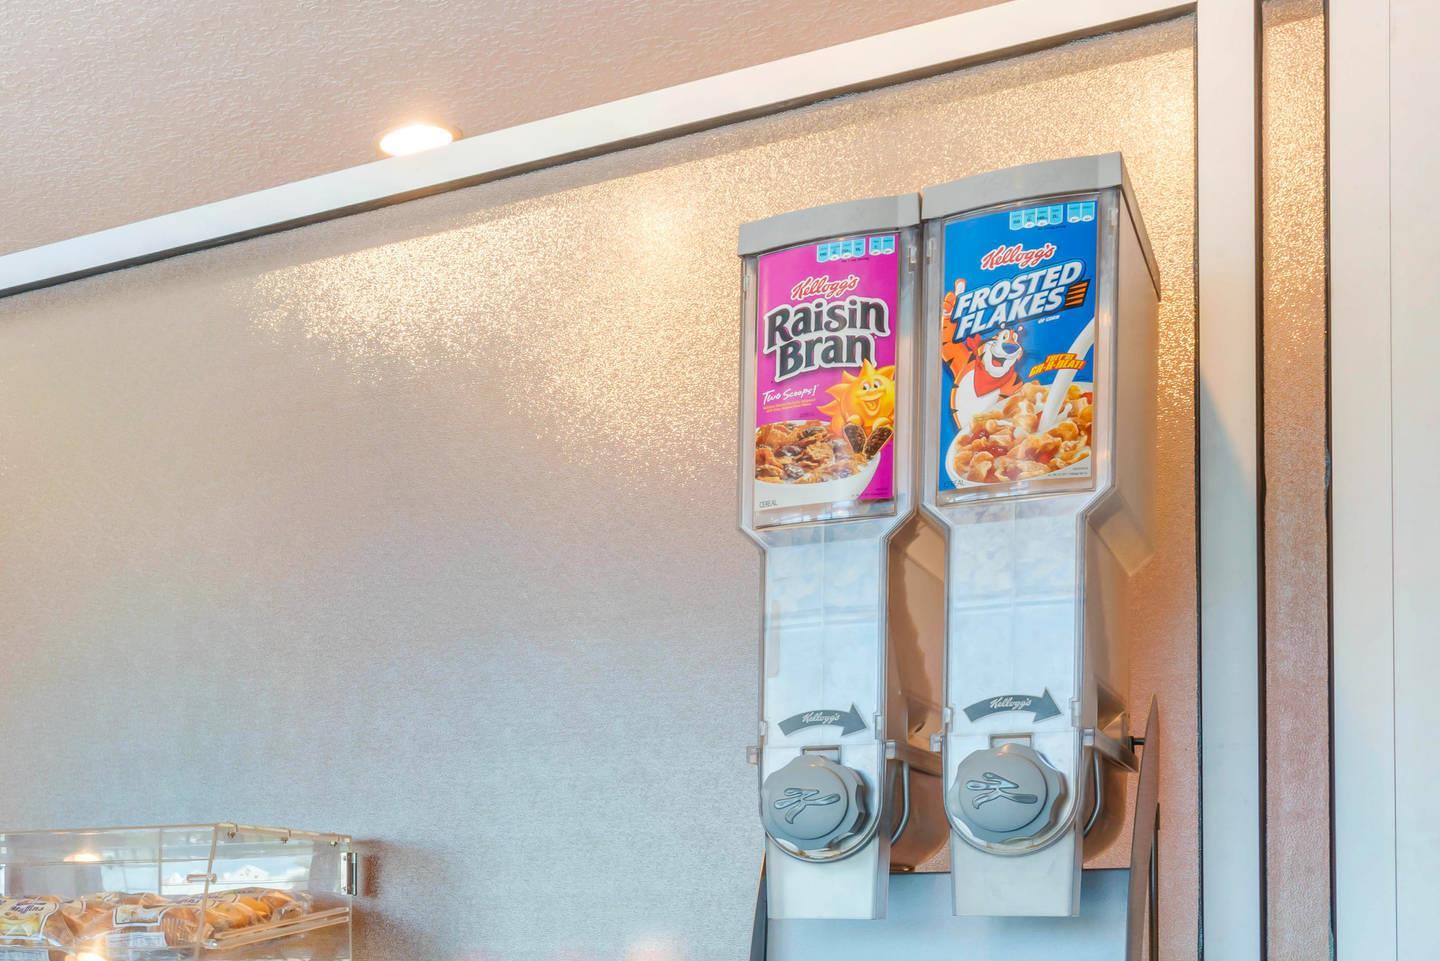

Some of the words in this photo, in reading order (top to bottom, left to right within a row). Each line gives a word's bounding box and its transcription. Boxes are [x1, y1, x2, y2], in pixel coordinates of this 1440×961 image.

[981, 243, 1056, 270] Kellogg's
[791, 275, 859, 300] Kellogg's
[953, 261, 1083, 320] FROSTED
[765, 297, 888, 351] Raisin
[955, 286, 1065, 341] FLAKES
[777, 335, 875, 381] Bran
[763, 389, 781, 405] Two
[783, 385, 817, 400] Scoops!
[988, 697, 1032, 710] Kellogg's
[802, 711, 840, 724] Kellogg's
